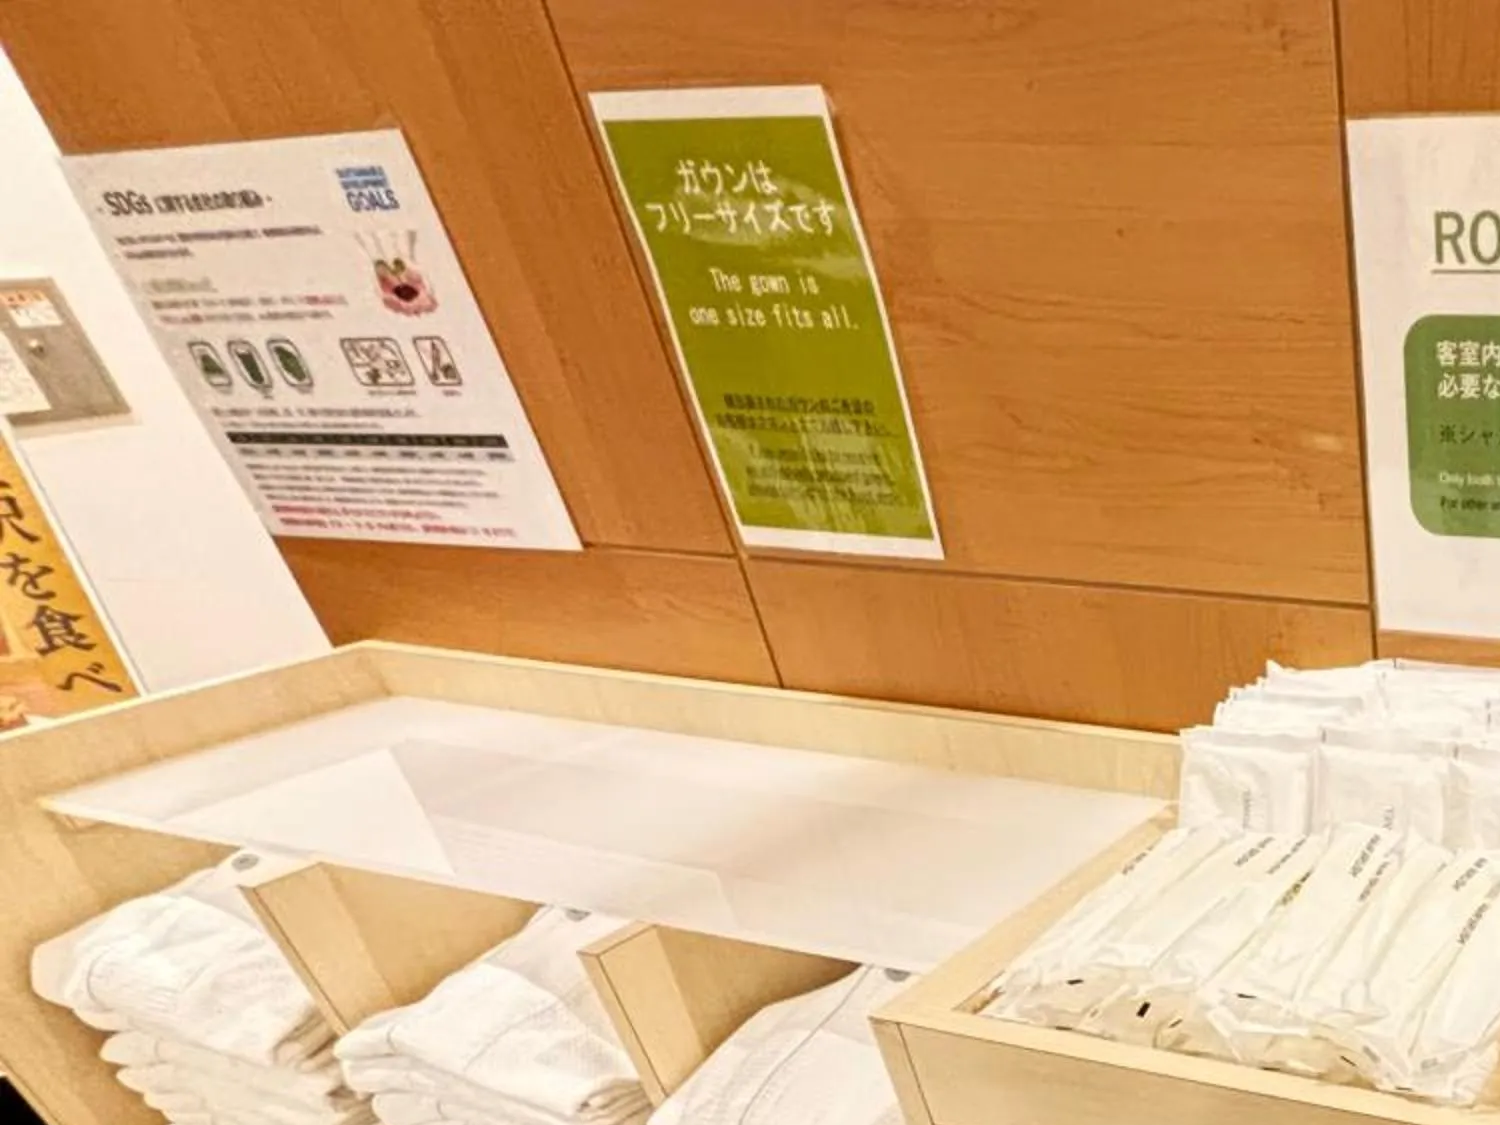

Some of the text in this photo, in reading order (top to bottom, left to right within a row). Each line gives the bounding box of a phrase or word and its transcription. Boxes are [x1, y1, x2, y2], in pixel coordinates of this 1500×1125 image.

[676, 159, 779, 195] ガウンは
[103, 190, 153, 216] SDGs
[346, 189, 400, 212] GOALS
[645, 198, 836, 235] フリーサイズです
[709, 266, 821, 297] The gown is
[689, 302, 860, 331] one size fits all.
